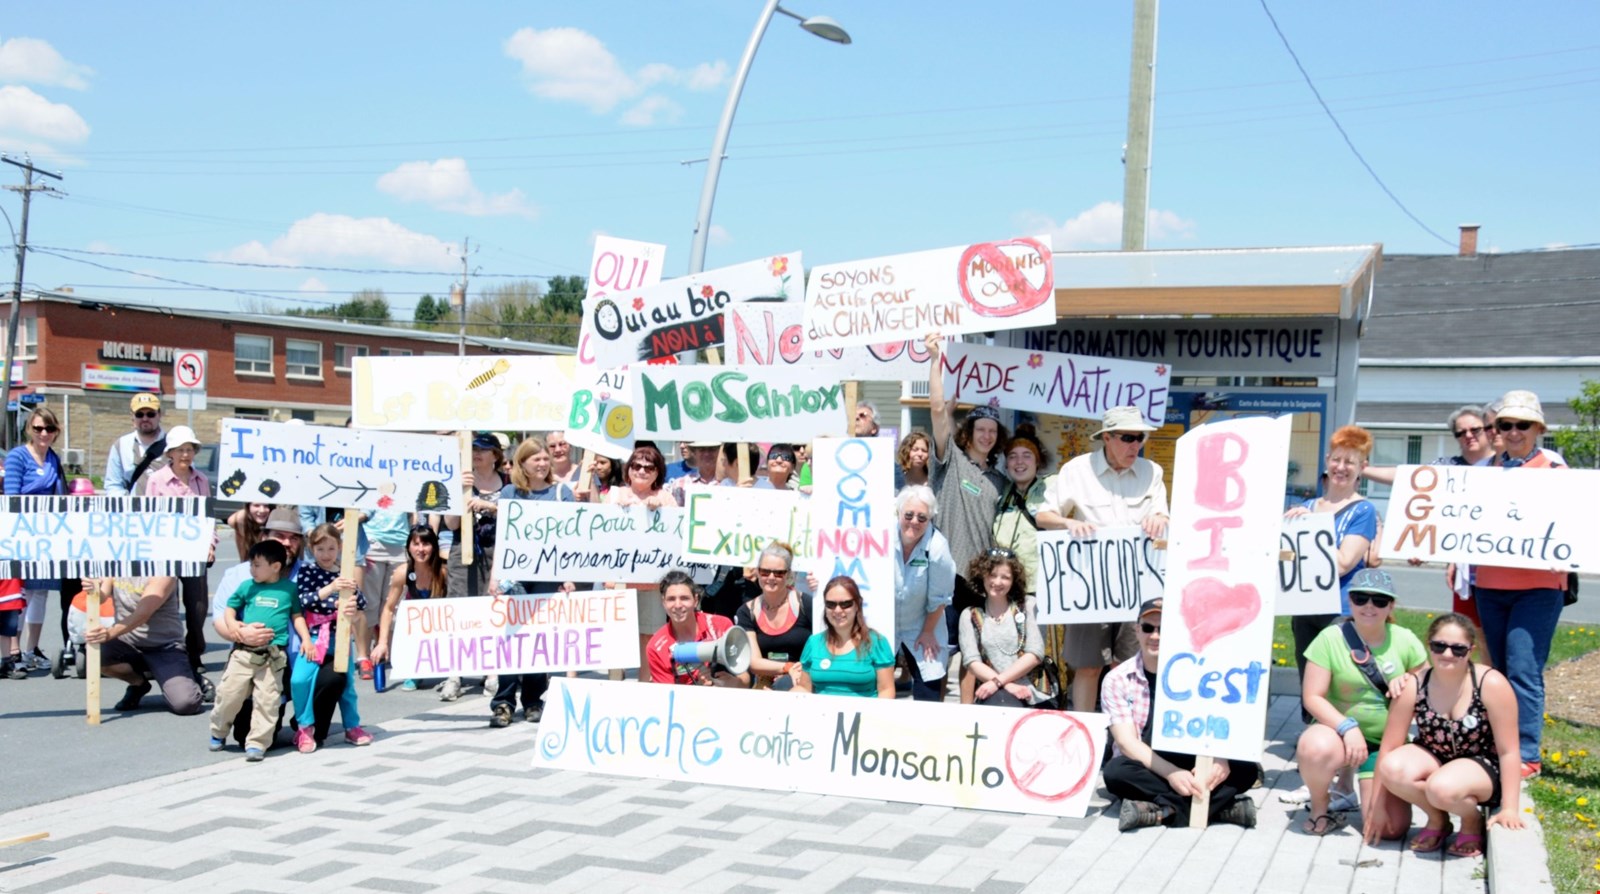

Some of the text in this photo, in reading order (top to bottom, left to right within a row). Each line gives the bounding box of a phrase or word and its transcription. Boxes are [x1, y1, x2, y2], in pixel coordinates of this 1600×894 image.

[594, 251, 649, 291] OUI
[820, 265, 895, 289] SOYONS
[594, 286, 730, 340] Oui au bio
[871, 288, 916, 314] pour
[808, 301, 964, 340] du CHANGEMENT
[103, 341, 147, 360] MICHEL
[652, 324, 699, 356] NON
[1024, 328, 1323, 362] INFORMATION TOURISTIQUE
[596, 372, 625, 390] AU
[941, 352, 1167, 423] MADE IN NATURE
[231, 428, 454, 482] I'm not round up ready
[1410, 465, 1468, 493] Oh!
[505, 501, 587, 544] Respect
[589, 513, 636, 540] pour
[1404, 494, 1483, 521] Gare
[11, 512, 201, 541] AUX BREVETS
[0, 538, 152, 561] SUR LA VIE
[817, 528, 889, 559] NON
[503, 548, 532, 569] De
[533, 545, 631, 576] Monsanto
[407, 593, 627, 635] POUR une SOUVERAINETÉ
[1161, 652, 1267, 704] C'est
[540, 681, 1004, 788] Marche contre Monsanto
